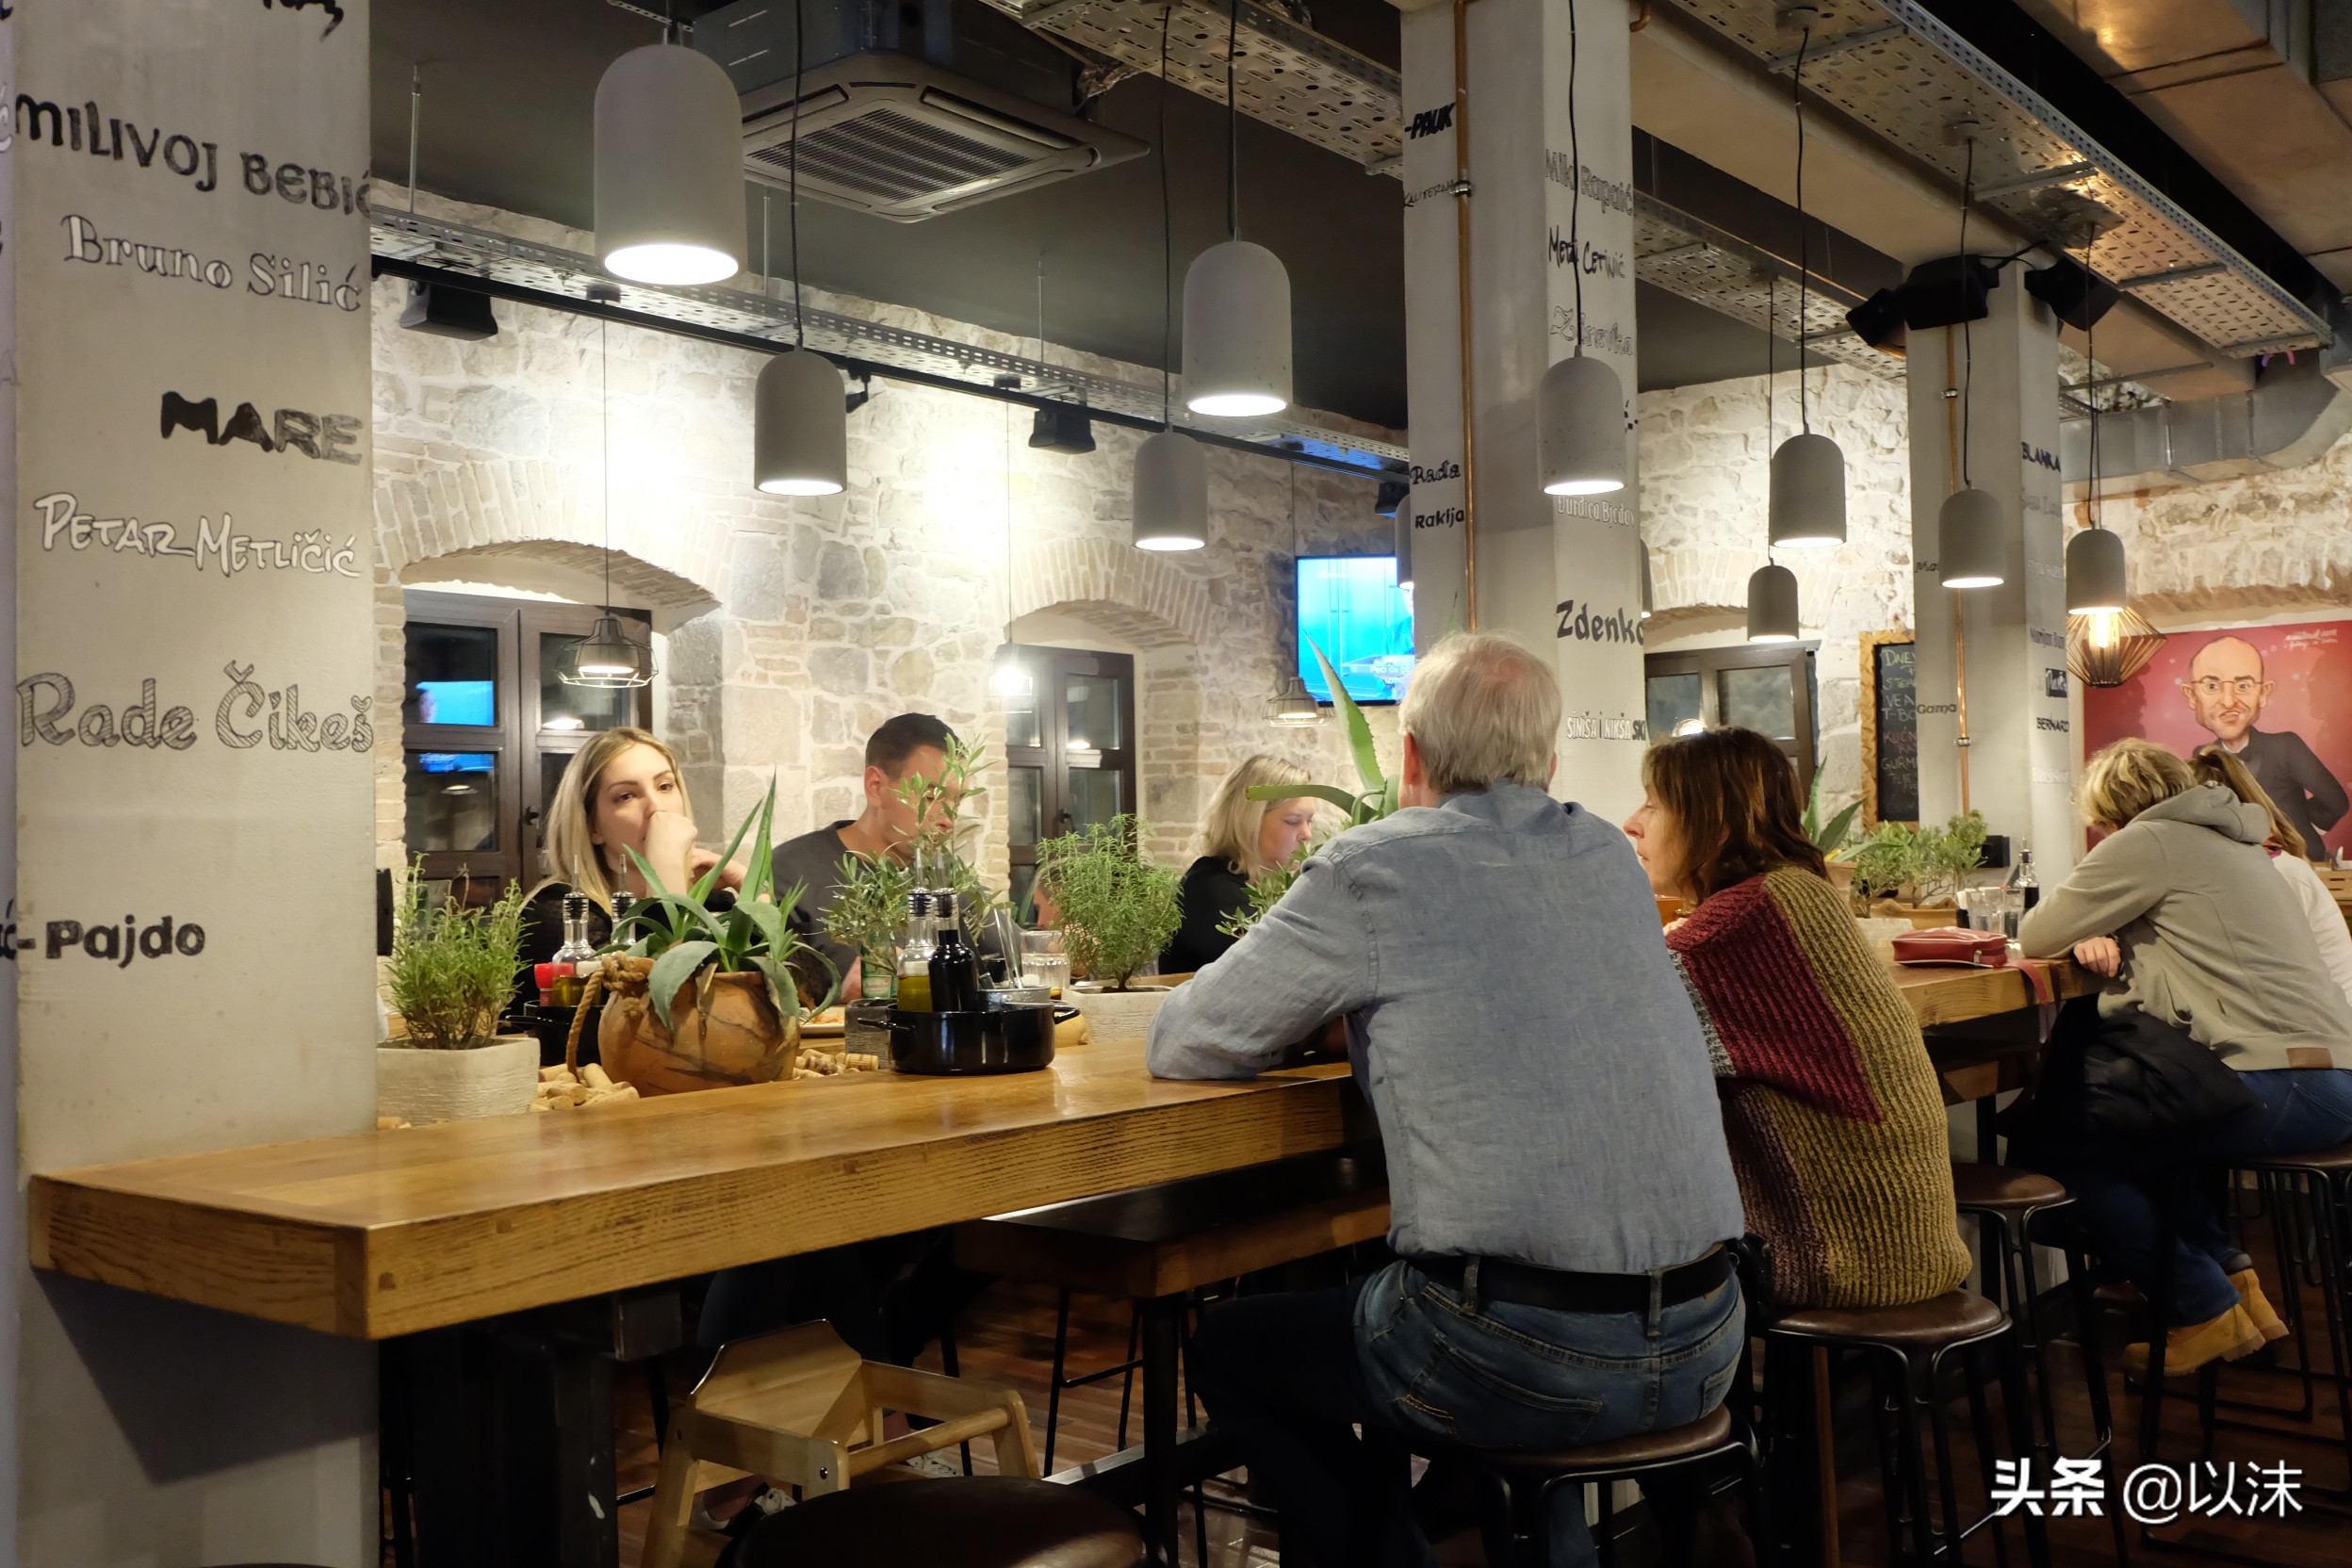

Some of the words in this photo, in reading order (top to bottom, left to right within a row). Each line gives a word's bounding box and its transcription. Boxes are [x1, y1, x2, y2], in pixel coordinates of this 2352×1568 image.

[60, 213, 234, 290] Bruno
[245, 252, 363, 313] Silić
[160, 390, 365, 467] MARE
[33, 491, 194, 558] PETAR
[15, 671, 198, 752] Rade
[214, 659, 375, 754] Čikeš
[45, 913, 206, 970] Pajdo
